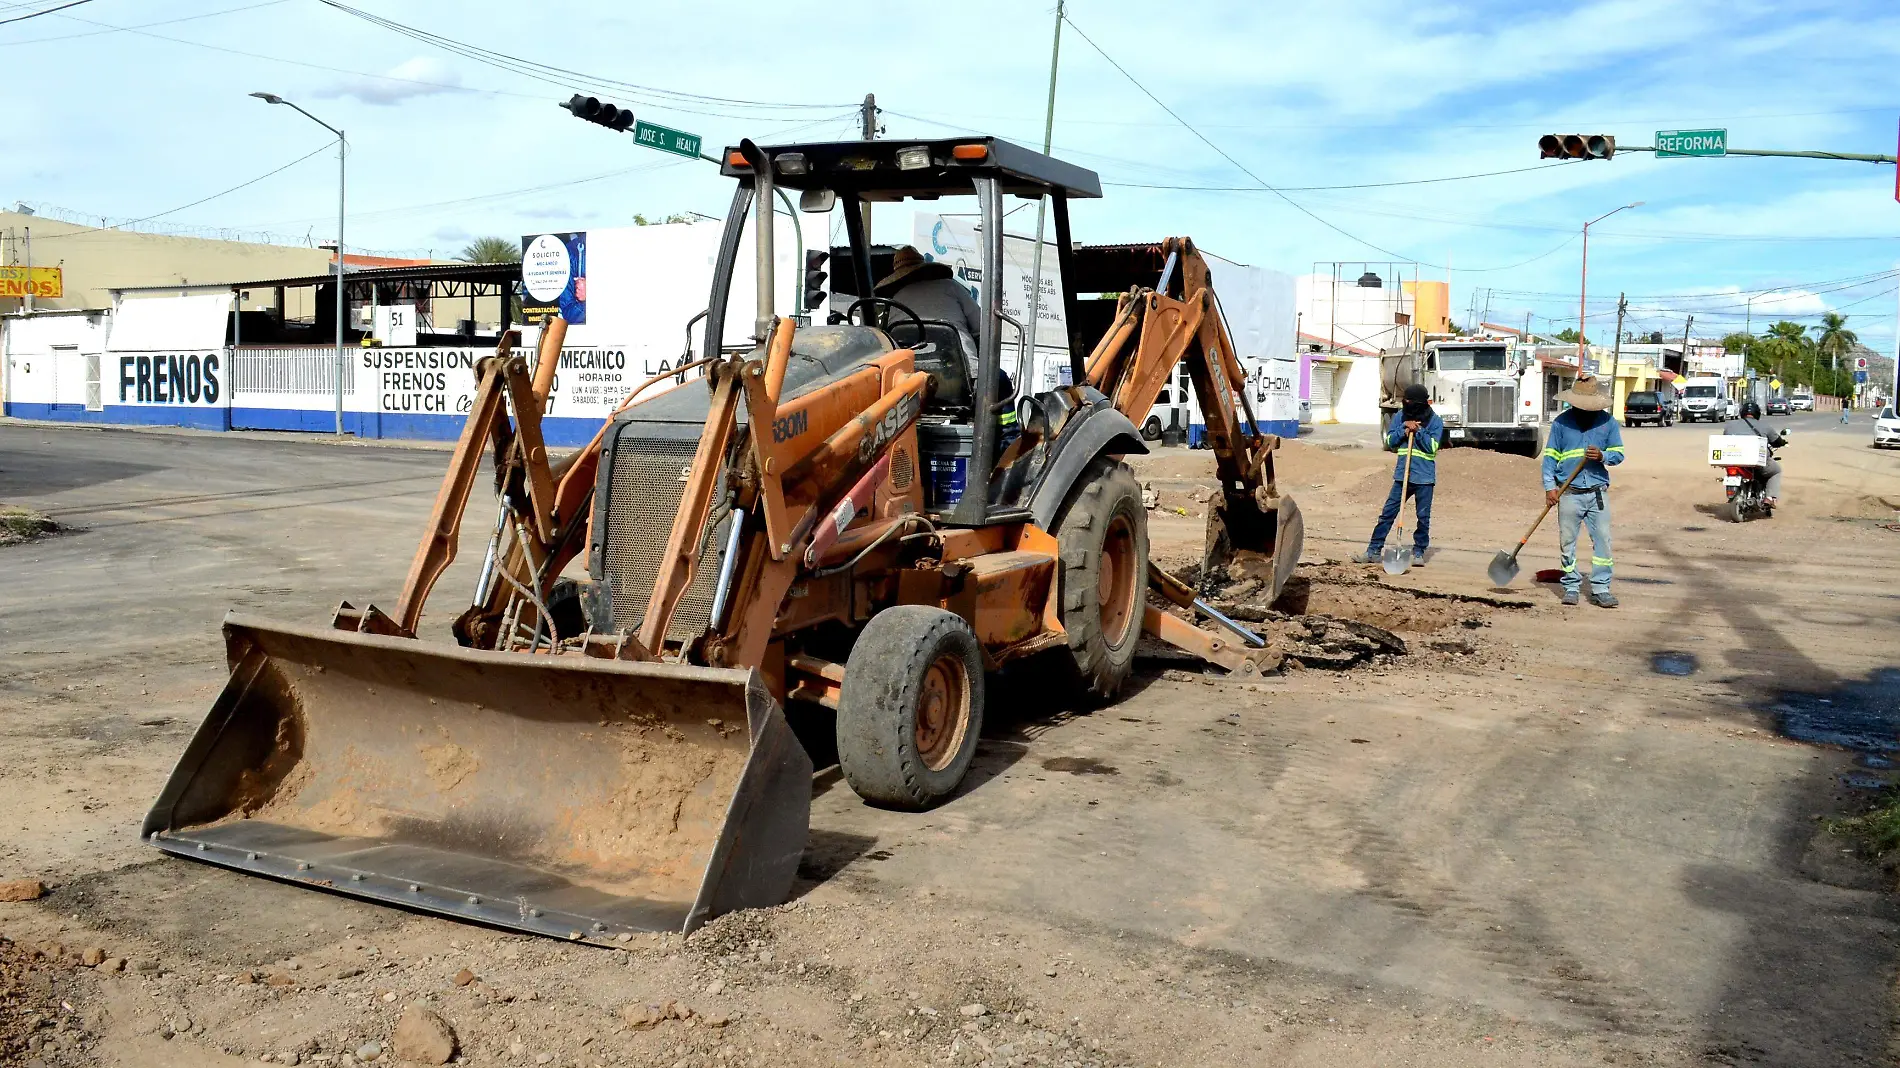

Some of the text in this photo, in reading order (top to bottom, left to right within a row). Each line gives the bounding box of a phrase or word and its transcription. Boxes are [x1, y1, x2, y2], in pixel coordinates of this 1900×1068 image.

[639, 128, 697, 153] JOSE S. HEALY
[1658, 136, 1723, 151] REFORMA
[1021, 274, 1044, 285] MÓDOS
[1023, 284, 1047, 294] SENRES
[391, 312, 403, 326] 51
[363, 351, 473, 369] SUSPENSION
[561, 350, 625, 369] MECANICO
[645, 359, 672, 376] LA
[119, 354, 219, 404] FRENOS
[383, 372, 446, 391] FRENOS
[578, 373, 622, 382] HORARIO
[1209, 347, 1229, 407] CASE
[1262, 376, 1290, 391] CHOYA
[383, 394, 475, 412] CLUTCH Ce
[858, 394, 910, 465] CASE
[1713, 450, 1721, 460] 21
